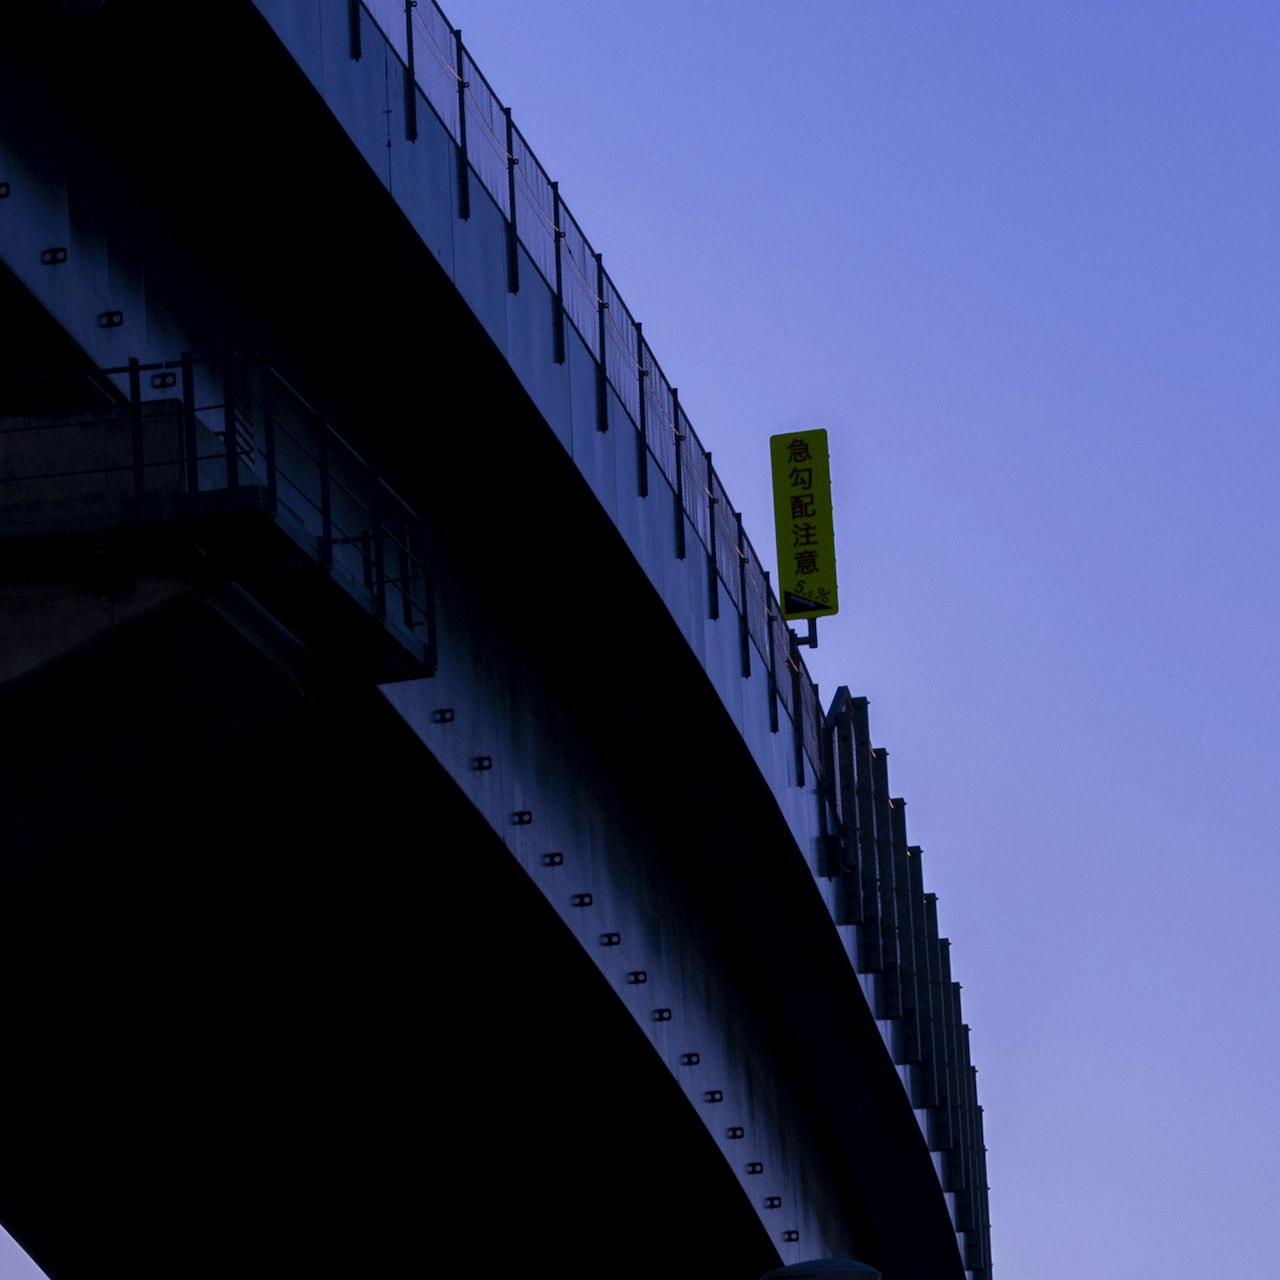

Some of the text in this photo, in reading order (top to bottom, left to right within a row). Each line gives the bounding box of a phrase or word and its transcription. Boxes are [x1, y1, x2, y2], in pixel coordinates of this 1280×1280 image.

[787, 438, 820, 575] 急勾配注意
